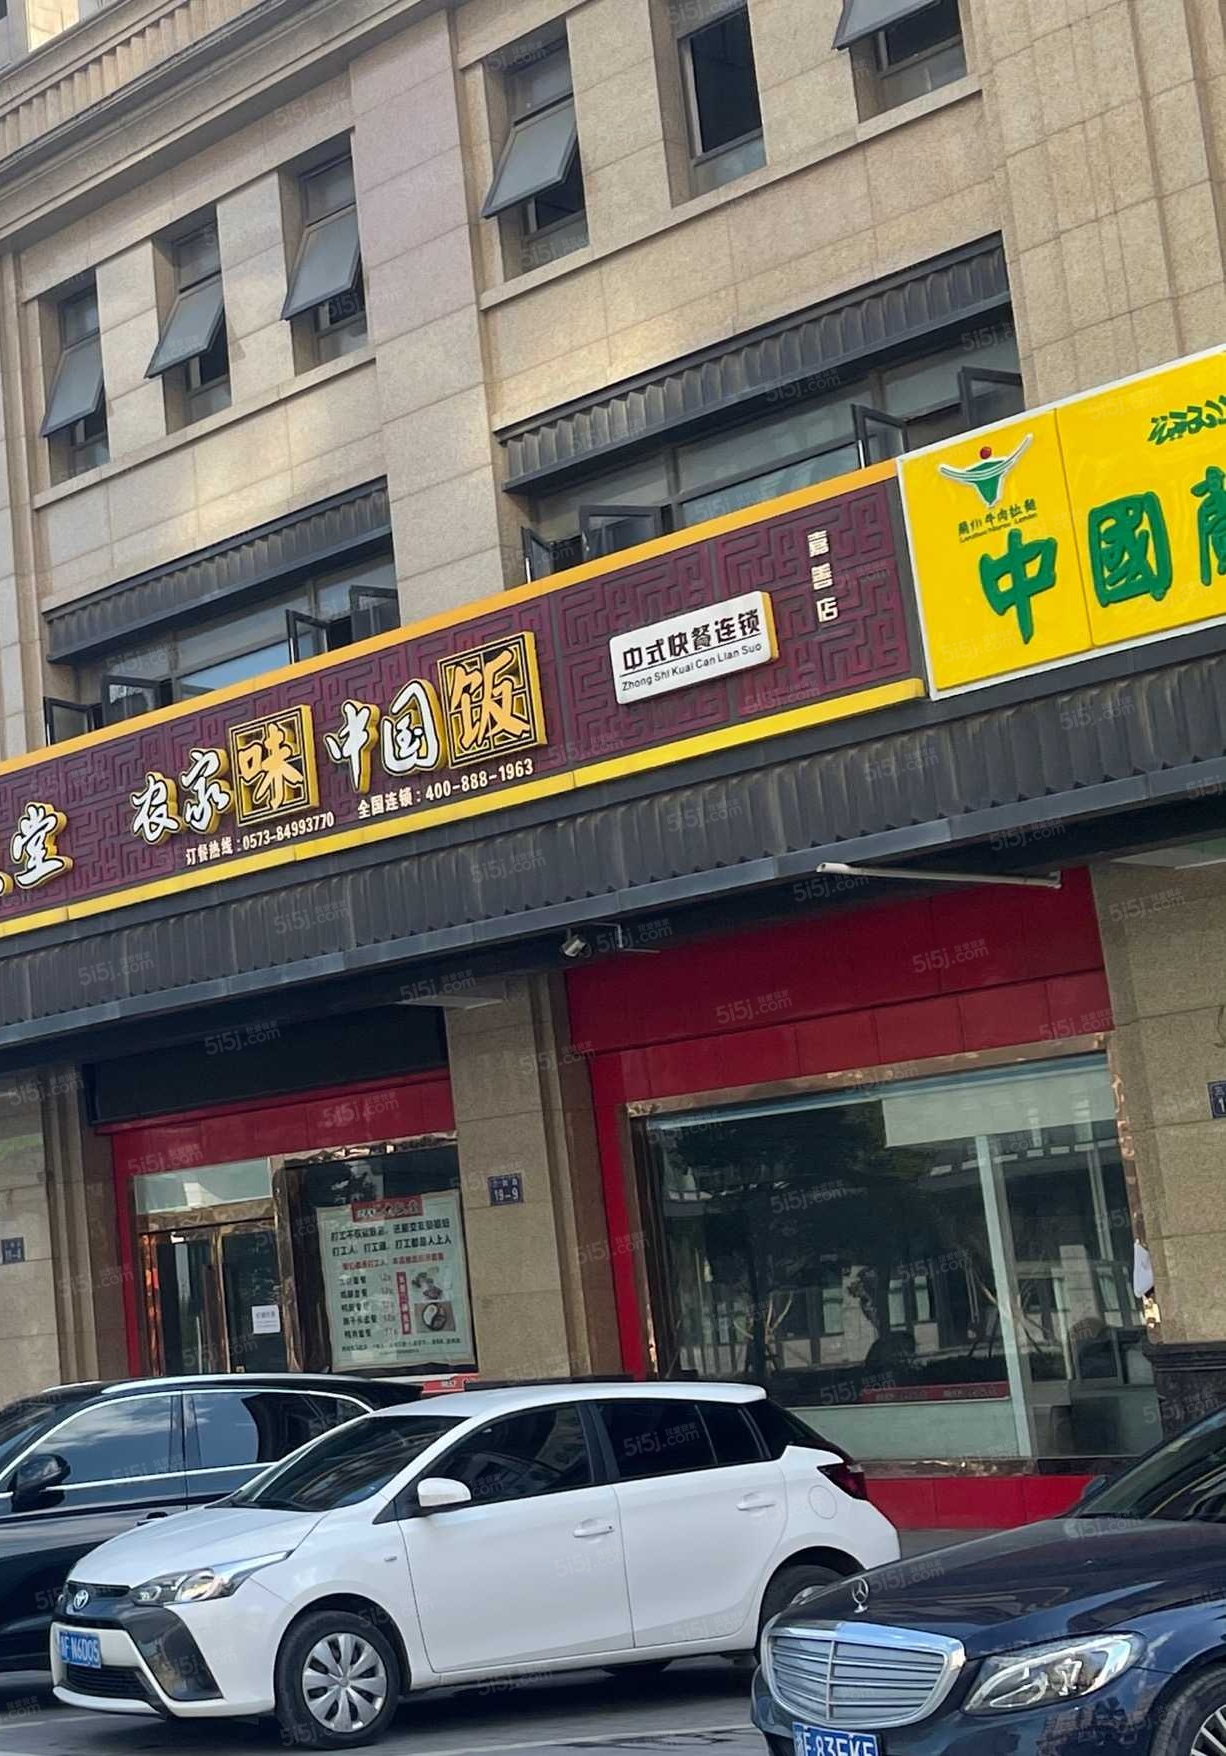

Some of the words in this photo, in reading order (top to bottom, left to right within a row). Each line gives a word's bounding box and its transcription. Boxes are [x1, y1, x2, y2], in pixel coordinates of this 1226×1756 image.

[621, 674, 653, 692] Zhong
[654, 668, 670, 682] Shi
[671, 662, 694, 676] Kuai
[695, 656, 716, 669] Can
[741, 642, 762, 656] Suo
[622, 608, 761, 671] 中式快餐连锁
